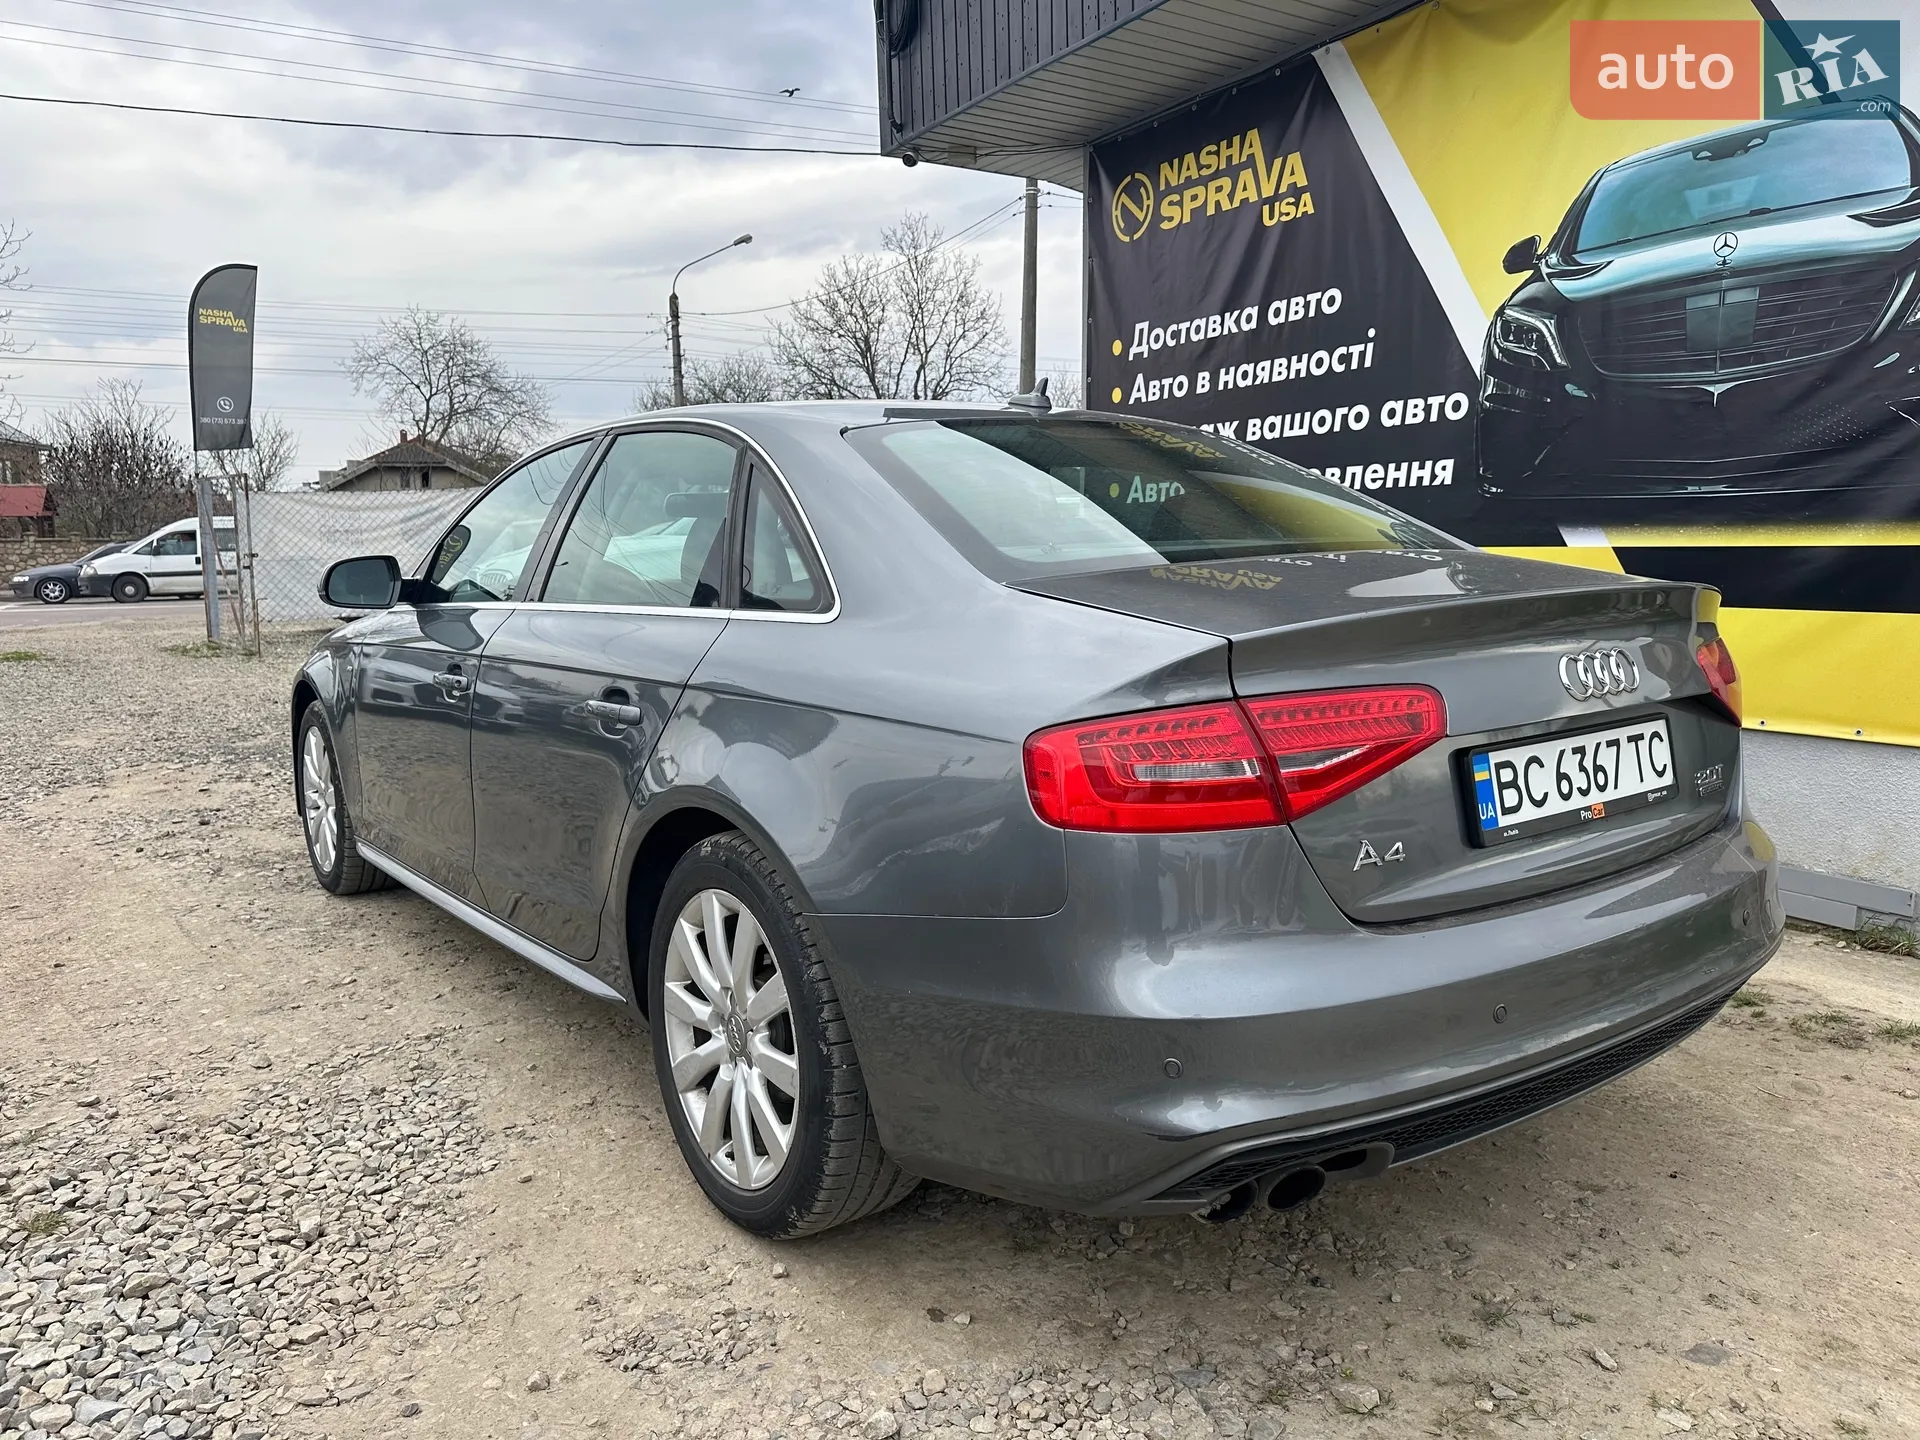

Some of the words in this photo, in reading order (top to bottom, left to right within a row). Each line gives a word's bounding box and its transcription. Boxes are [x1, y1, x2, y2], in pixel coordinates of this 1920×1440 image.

[1159, 128, 1262, 191] NASHA
[1159, 151, 1309, 231] SPRAVA
[1261, 192, 1316, 227] USA
[199, 307, 234, 318] NASHA
[199, 315, 246, 327] SPRAVA
[1128, 309, 1258, 361] Доставка
[1267, 287, 1343, 326] авто
[1128, 372, 1189, 405] Авто
[1196, 370, 1210, 394] в
[1218, 327, 1377, 391] наявності
[1246, 404, 1370, 442] вашого
[1380, 391, 1470, 428] авто
[1494, 754, 1549, 816] BC
[1555, 737, 1621, 801] 6367
[1626, 730, 1668, 783] TC
[1478, 802, 1496, 820] UA
[1352, 839, 1406, 872] A4
